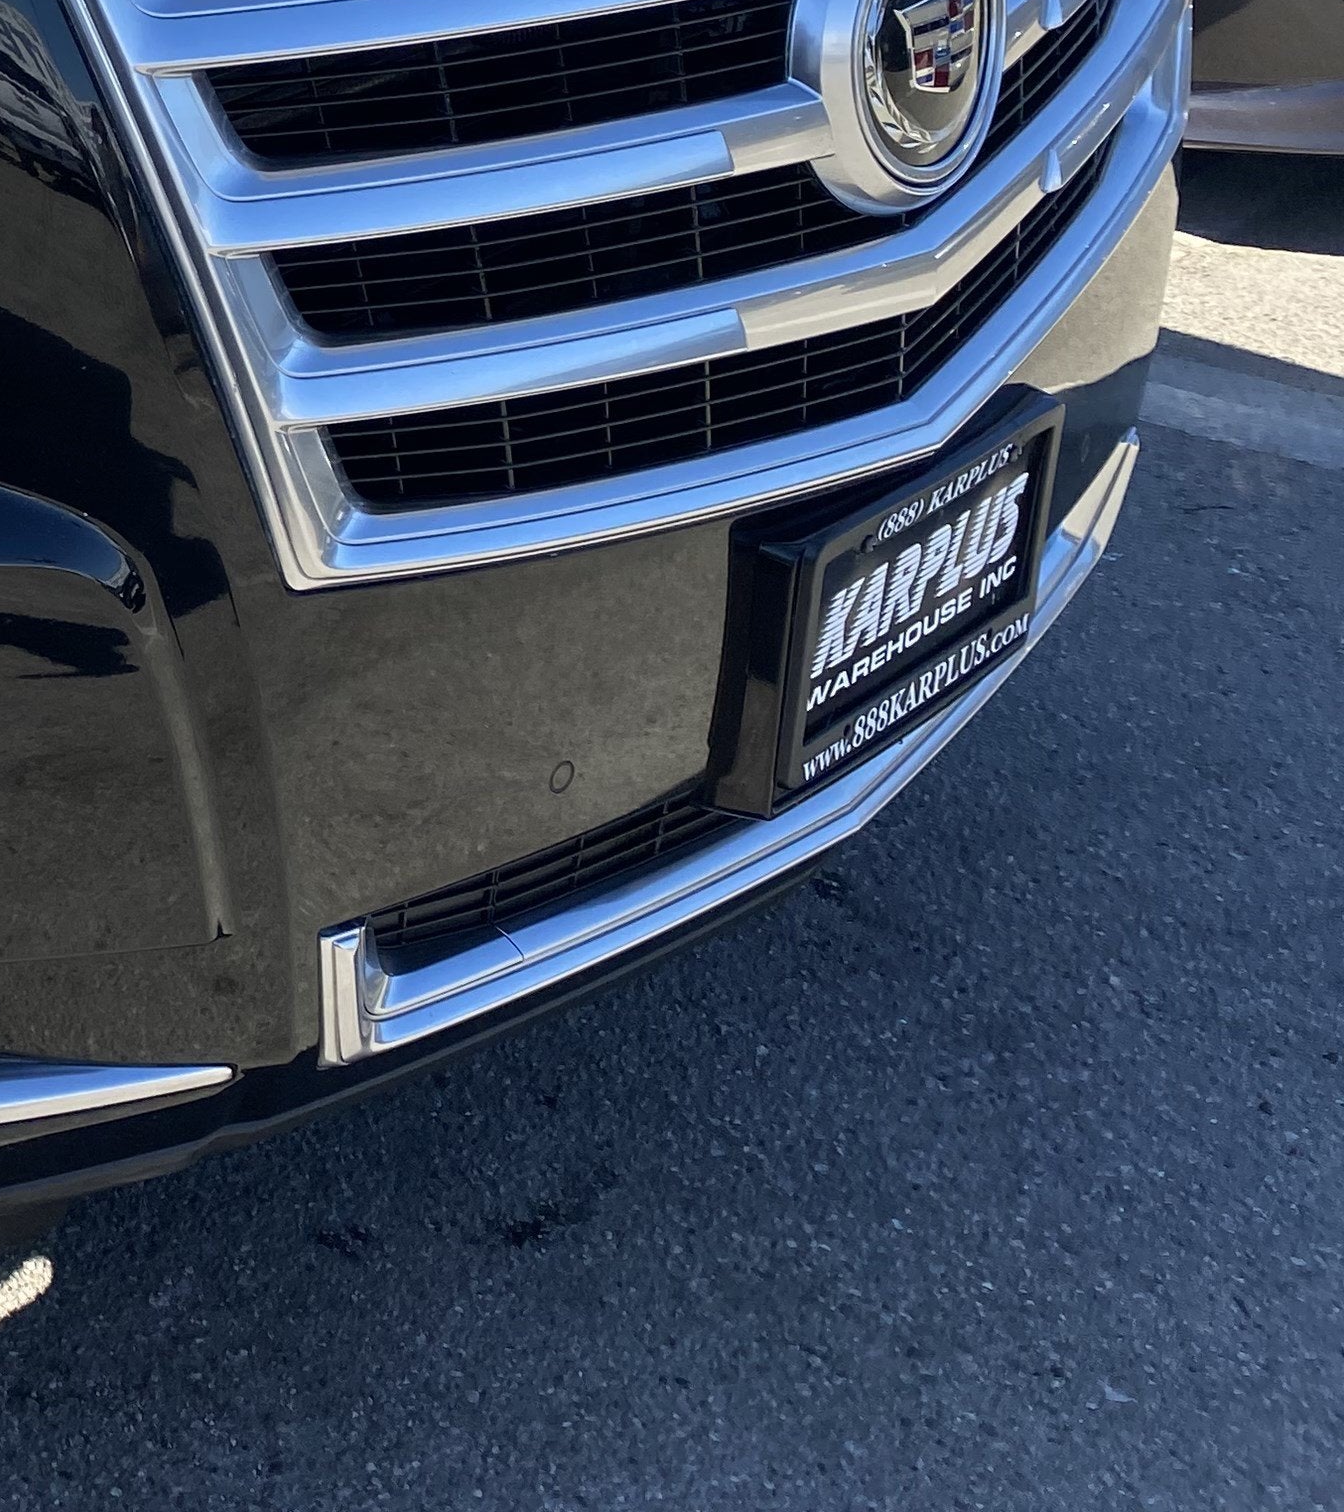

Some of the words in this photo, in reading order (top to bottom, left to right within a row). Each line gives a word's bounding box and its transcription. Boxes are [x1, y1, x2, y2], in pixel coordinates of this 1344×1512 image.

[877, 498, 925, 542] (888)
[927, 443, 1014, 516] KARPLUS
[807, 587, 973, 712] WAREHOUSE
[979, 555, 1017, 599] INC
[810, 472, 1030, 679] KARPLUS
